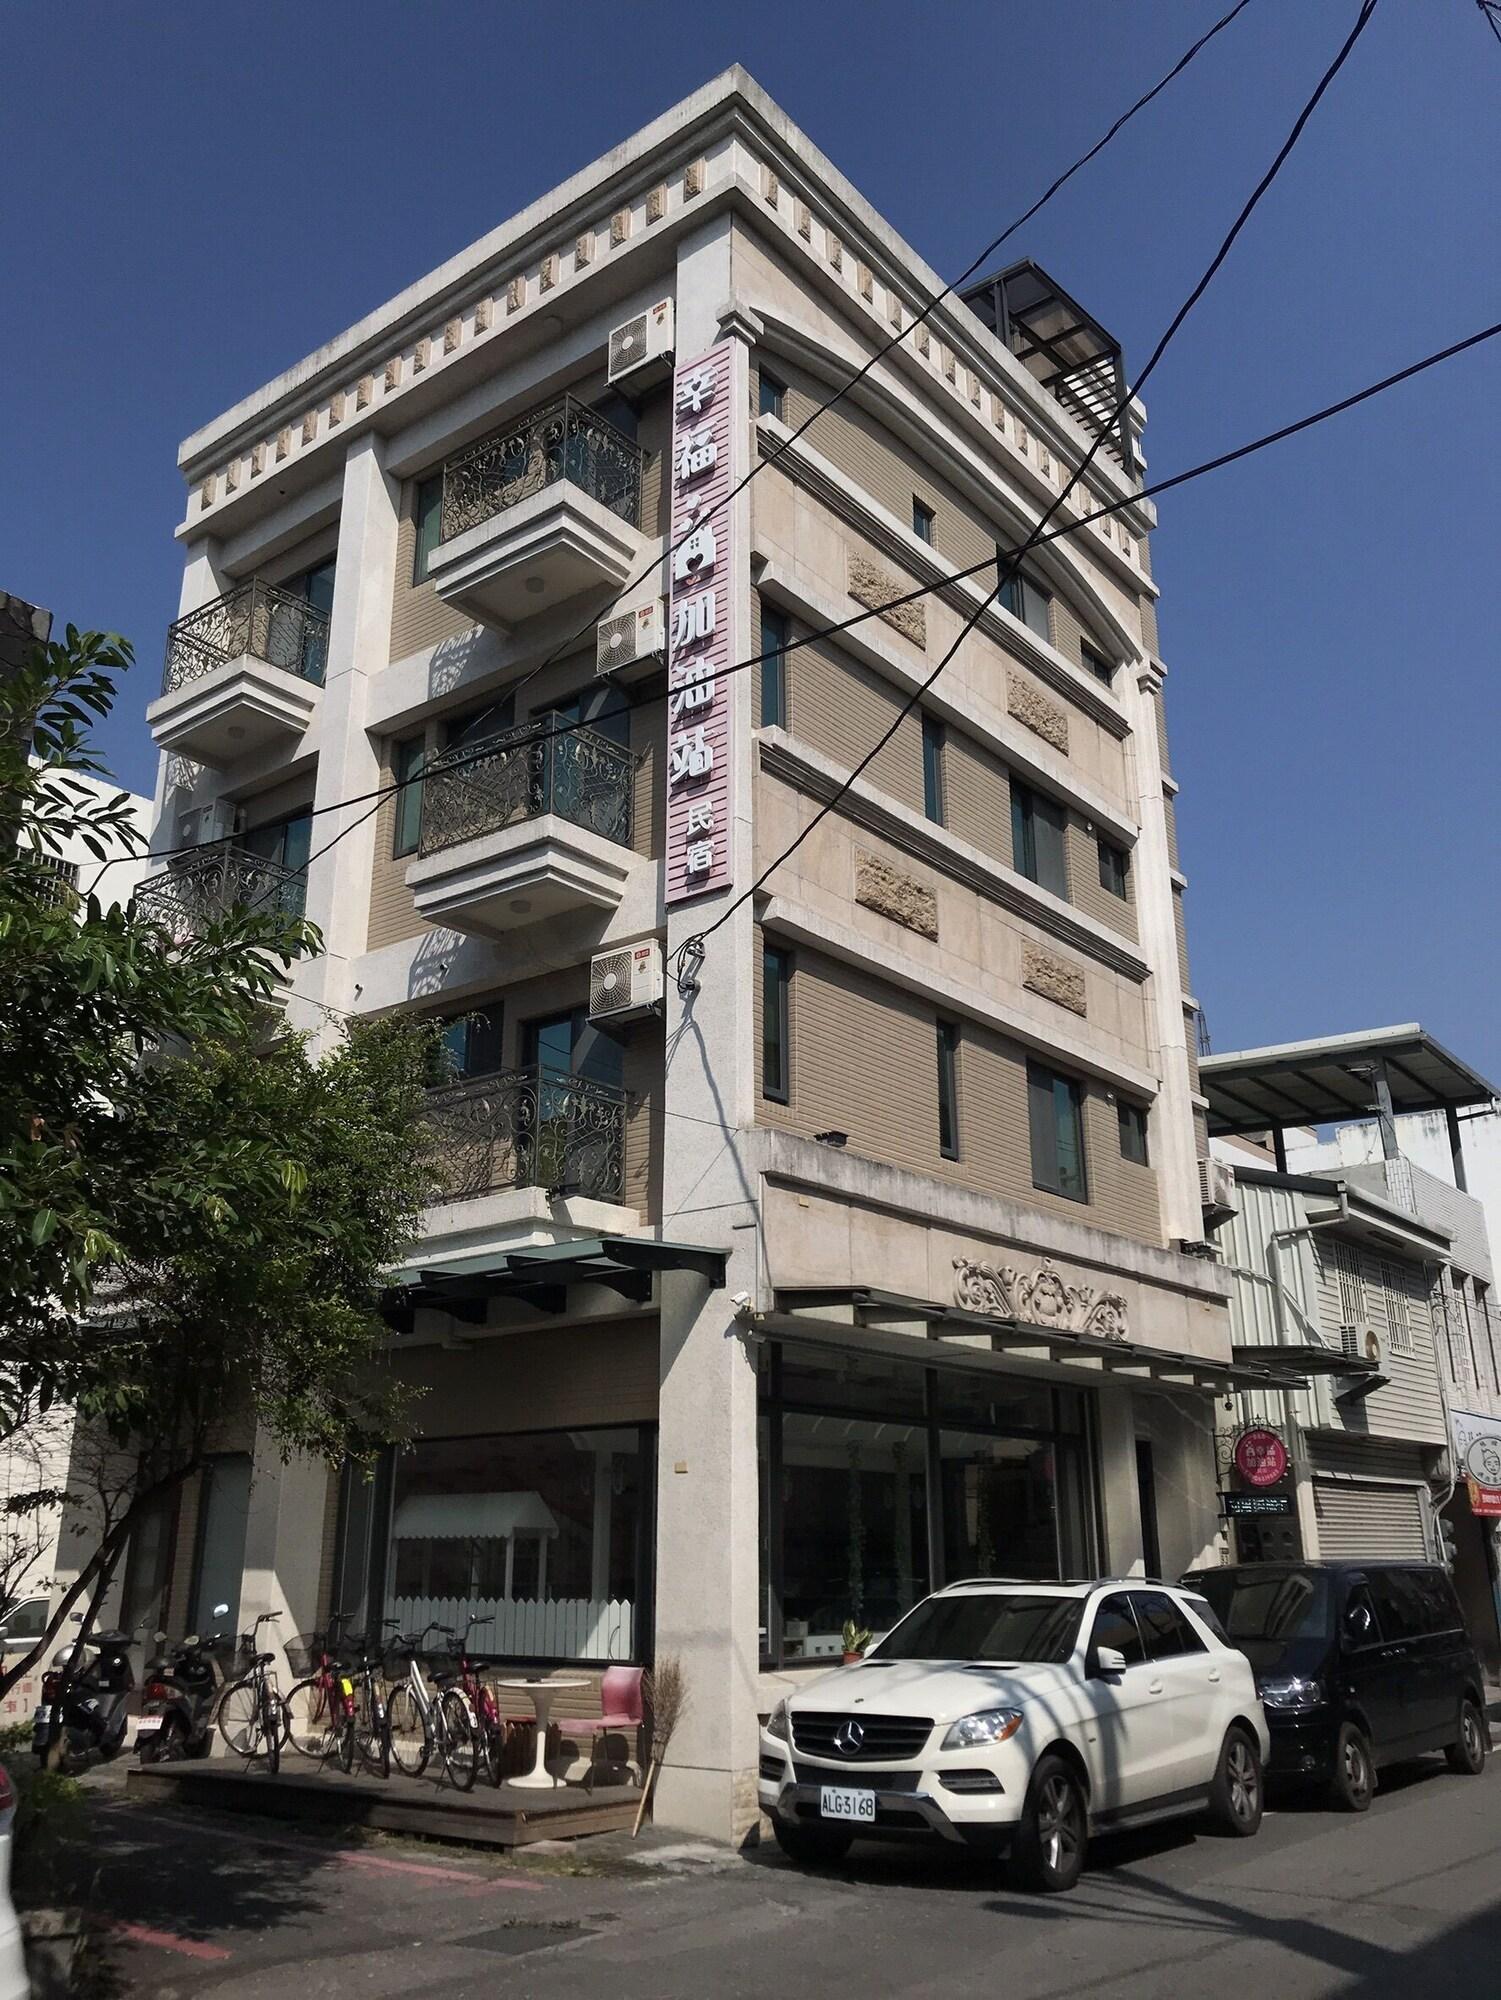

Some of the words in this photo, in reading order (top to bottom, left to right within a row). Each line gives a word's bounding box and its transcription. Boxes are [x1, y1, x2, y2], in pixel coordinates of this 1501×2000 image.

[676, 366, 719, 480] 幸福
[671, 591, 716, 785] 加油站
[686, 800, 716, 874] 民宿
